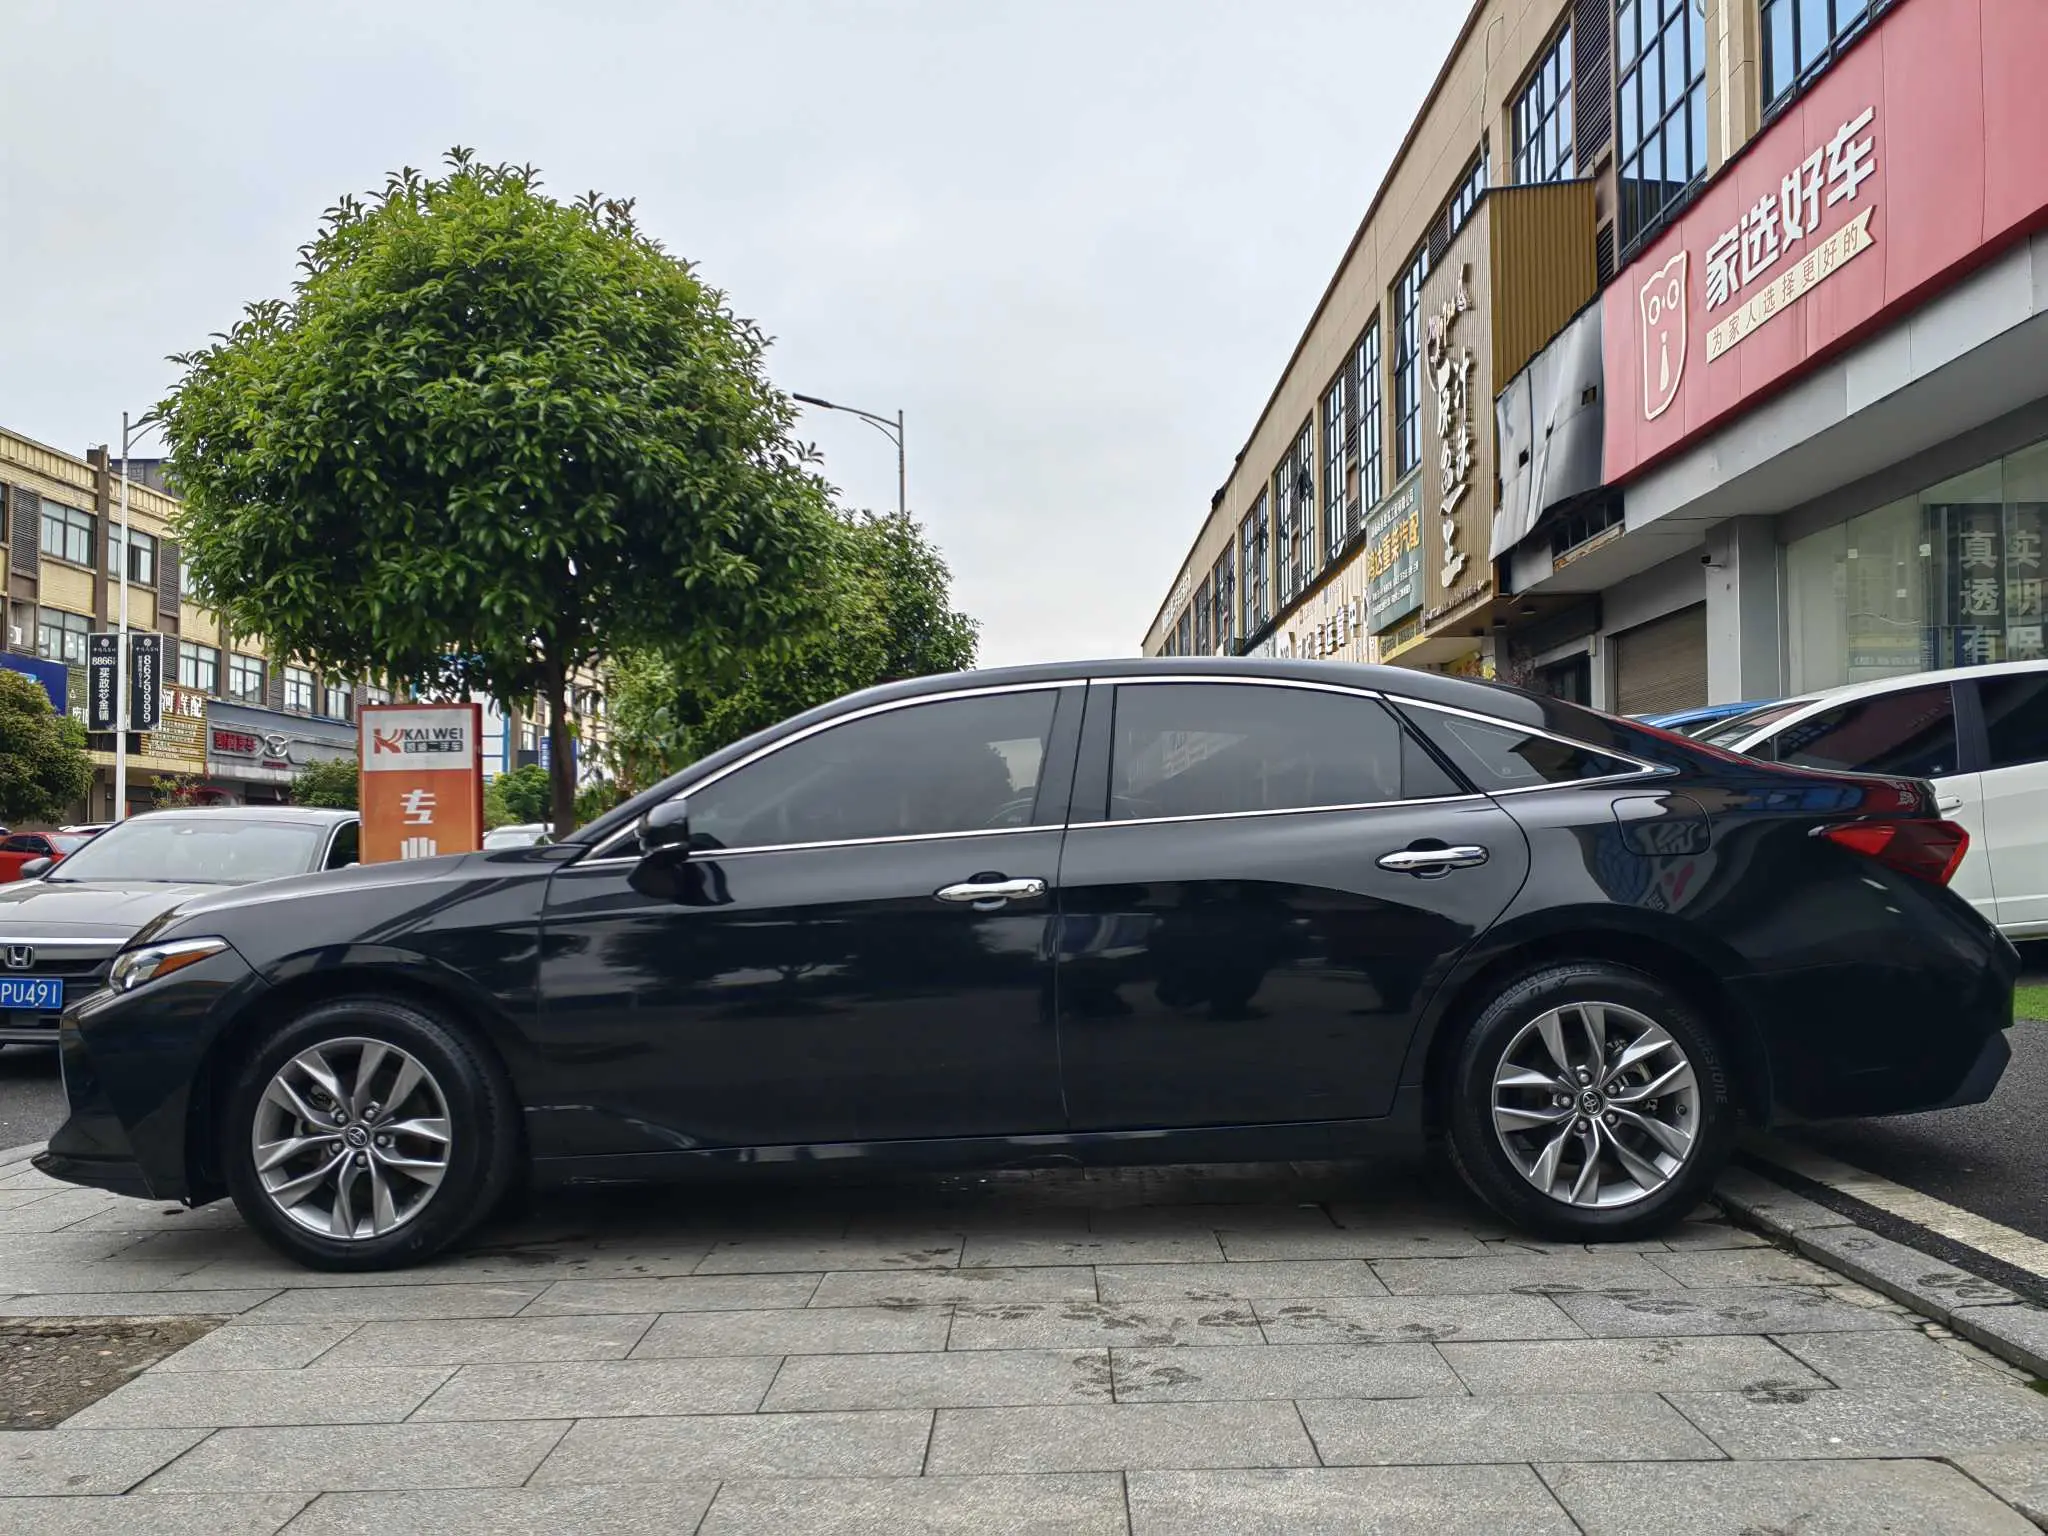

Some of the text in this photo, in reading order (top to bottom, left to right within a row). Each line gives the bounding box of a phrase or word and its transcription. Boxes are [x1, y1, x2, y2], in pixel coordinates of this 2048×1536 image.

[1706, 105, 1875, 312] 家选好车
[1711, 222, 1859, 354] 为家人选择更好的
[1960, 530, 2042, 569] 真实
[1960, 577, 2042, 616] 透明
[404, 727, 463, 740] KAI WEI
[1, 982, 57, 1004] PU491
